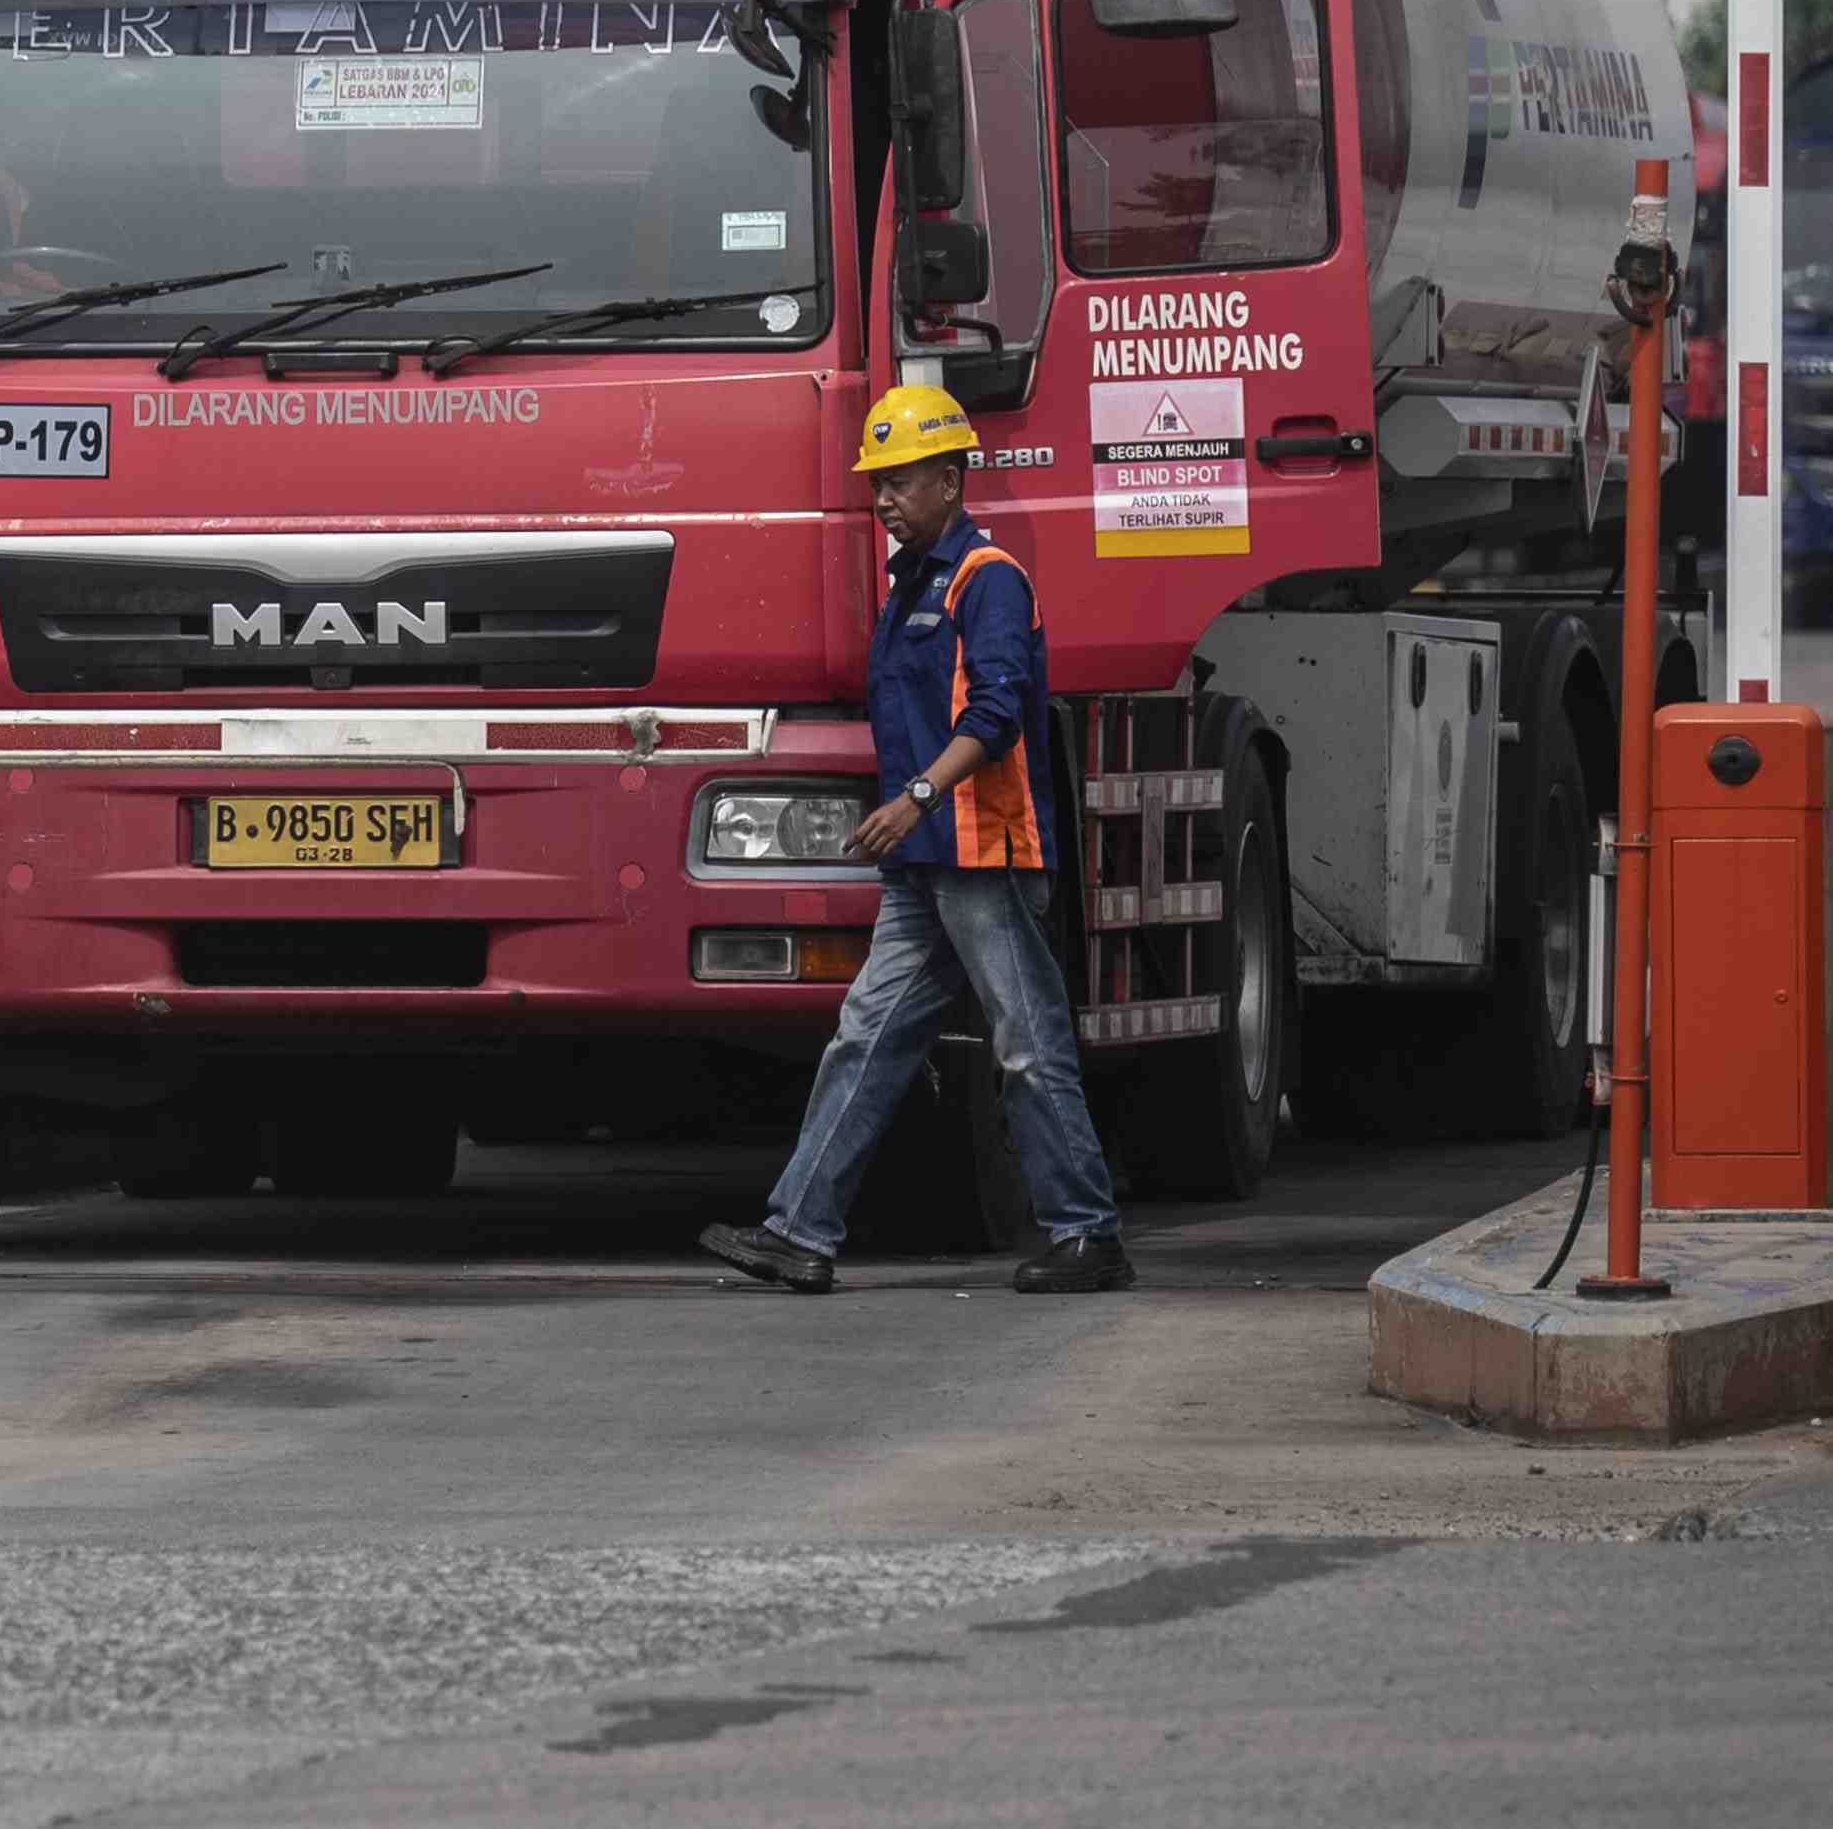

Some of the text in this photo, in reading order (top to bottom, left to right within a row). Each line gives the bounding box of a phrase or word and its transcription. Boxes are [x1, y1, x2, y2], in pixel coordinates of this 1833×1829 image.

[339, 83, 408, 99] LEBARAN
[1088, 290, 1249, 332] DILARANG
[1092, 333, 1303, 377] MENUMPANG
[132, 388, 540, 428] DILARANG MENUMPANG
[1108, 442, 1229, 460] SEGERA MENJAUH
[1117, 466, 1222, 487] BLIND SPOT
[1131, 493, 1211, 508] ANDA TIDAK
[1119, 511, 1224, 528] TERLIHAT SUPIR
[212, 602, 446, 646] MAN
[217, 805, 236, 842] B
[266, 804, 353, 842] 9850
